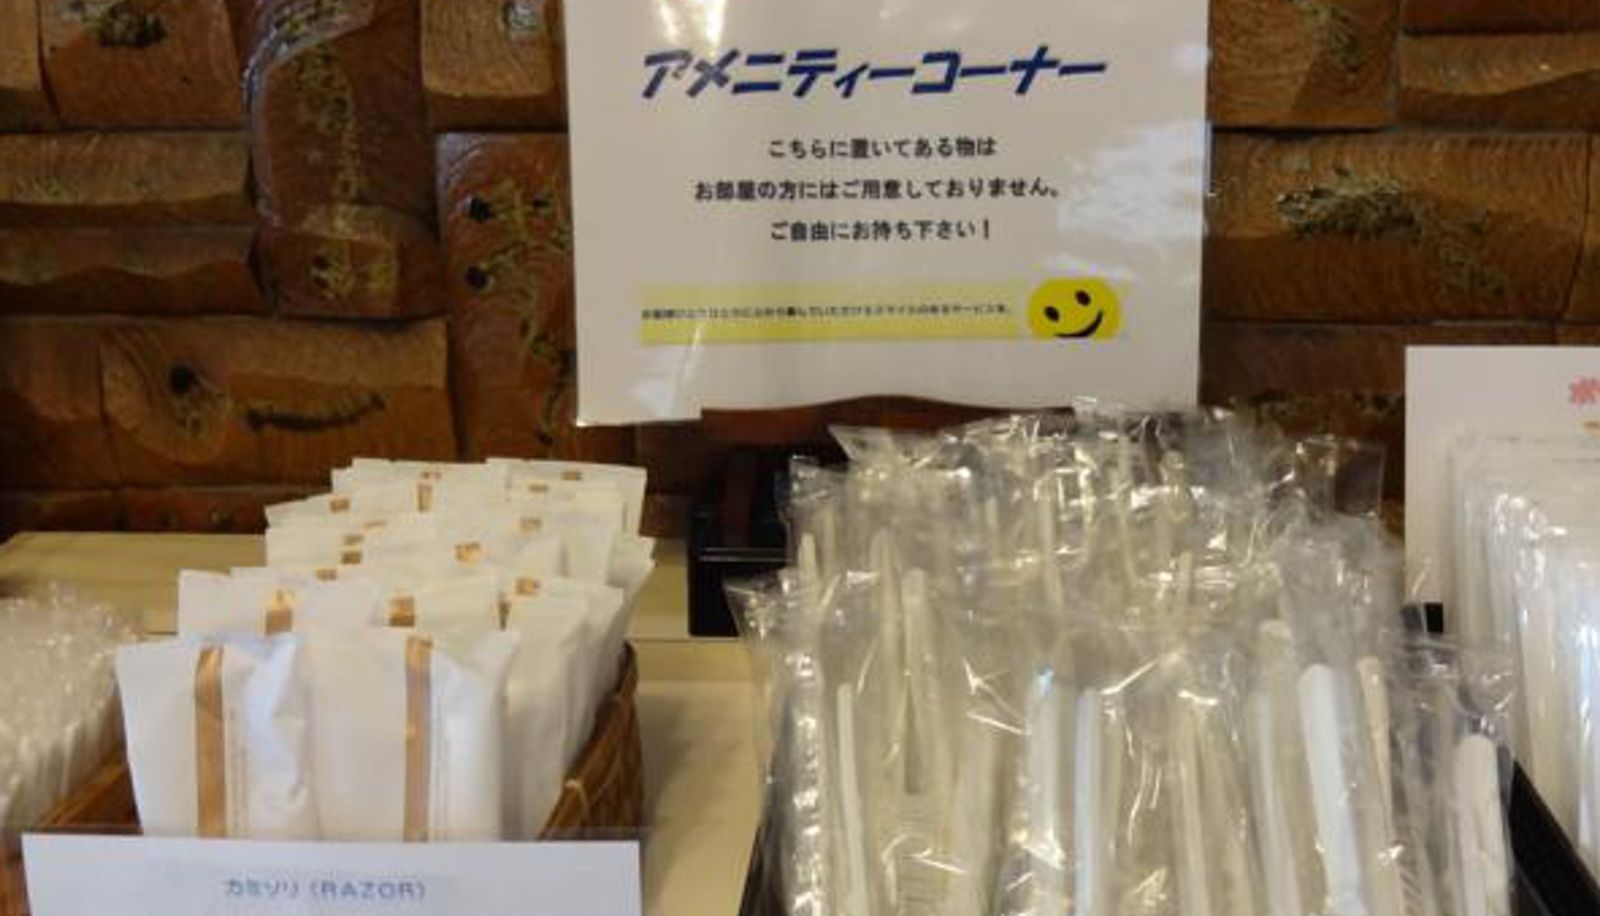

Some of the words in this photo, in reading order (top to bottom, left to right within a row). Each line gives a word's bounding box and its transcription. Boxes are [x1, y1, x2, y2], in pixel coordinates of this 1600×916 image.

[641, 44, 1108, 99] アメニティーコーナー
[768, 137, 997, 160] こちらに置いてある物は
[695, 177, 1061, 201] お部屋の方にはご用意しておりません。
